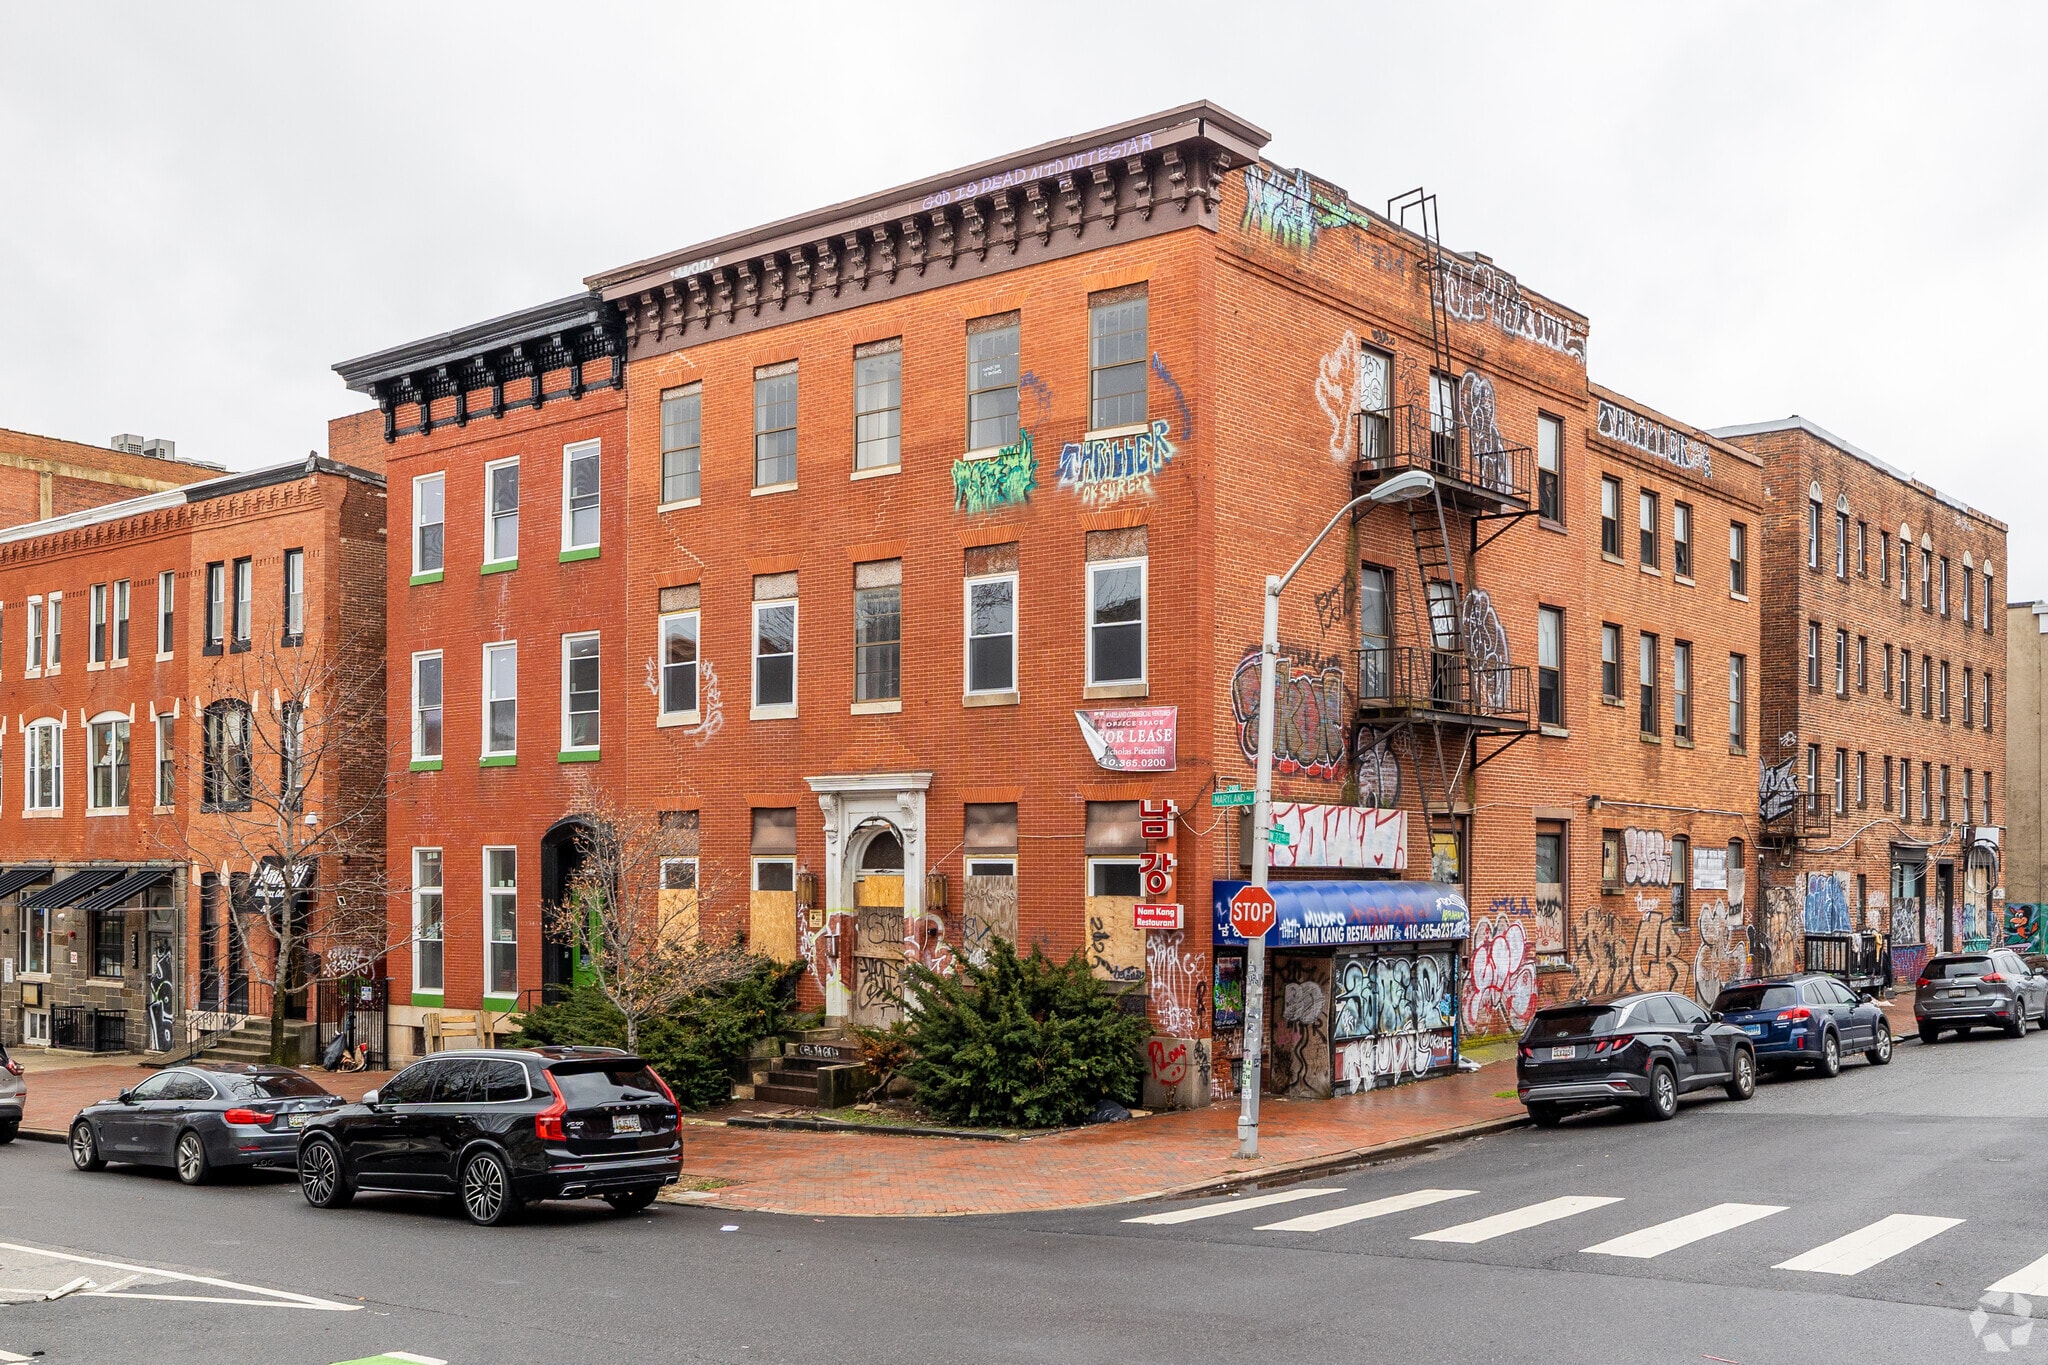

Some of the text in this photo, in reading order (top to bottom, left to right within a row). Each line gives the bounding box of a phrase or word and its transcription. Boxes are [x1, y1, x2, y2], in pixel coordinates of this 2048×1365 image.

[922, 190, 950, 210] GOD
[981, 169, 1027, 194] DEAD
[1129, 729, 1172, 743] LEASE
[1107, 747, 1131, 755] icholas
[1103, 758, 1166, 767] 10.365.0200
[1214, 793, 1246, 804] MARYLAND
[1137, 907, 1175, 918] Nam Kang
[1233, 901, 1273, 923] STOP
[1137, 917, 1175, 927] Restaurant
[1300, 927, 1320, 945] NAM
[1321, 926, 1345, 943] KANG
[1346, 924, 1394, 943] RESTAURANT
